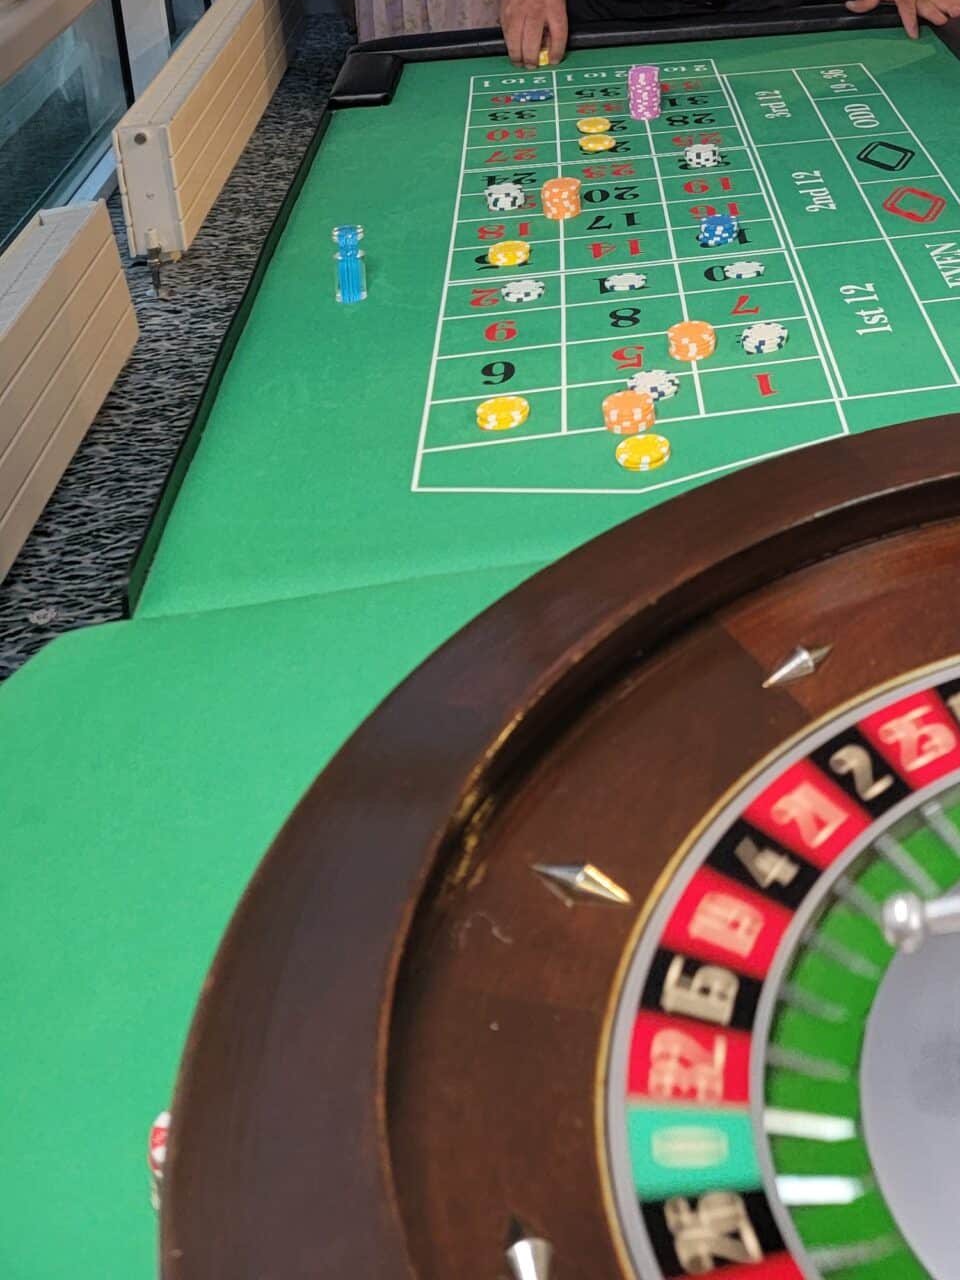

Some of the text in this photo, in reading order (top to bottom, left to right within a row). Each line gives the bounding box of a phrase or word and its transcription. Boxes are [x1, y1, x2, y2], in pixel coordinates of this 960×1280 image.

[532, 76, 547, 85] 2
[575, 87, 621, 99] 35
[667, 95, 710, 107] 31
[487, 108, 537, 121] 33
[754, 90, 793, 120] 3rd 12
[843, 103, 880, 129] ODD
[665, 112, 716, 127] 28
[486, 127, 537, 141] 30
[484, 147, 538, 163] 27
[582, 164, 636, 179] 23
[583, 186, 641, 204] 20
[683, 177, 734, 194] 19
[791, 170, 837, 213] 2nd 12
[585, 212, 642, 231] 17
[689, 202, 741, 220] 16
[477, 222, 531, 240] 18
[586, 238, 645, 260] 14
[730, 294, 761, 316] 7
[839, 282, 894, 336] 1st 12
[609, 307, 642, 329] 8
[484, 320, 518, 342] 9
[611, 345, 646, 370] 5
[481, 361, 516, 385] 6
[753, 372, 780, 398] 1
[829, 744, 894, 803] 2
[735, 835, 801, 890] 4
[651, 1124, 730, 1170] 0
